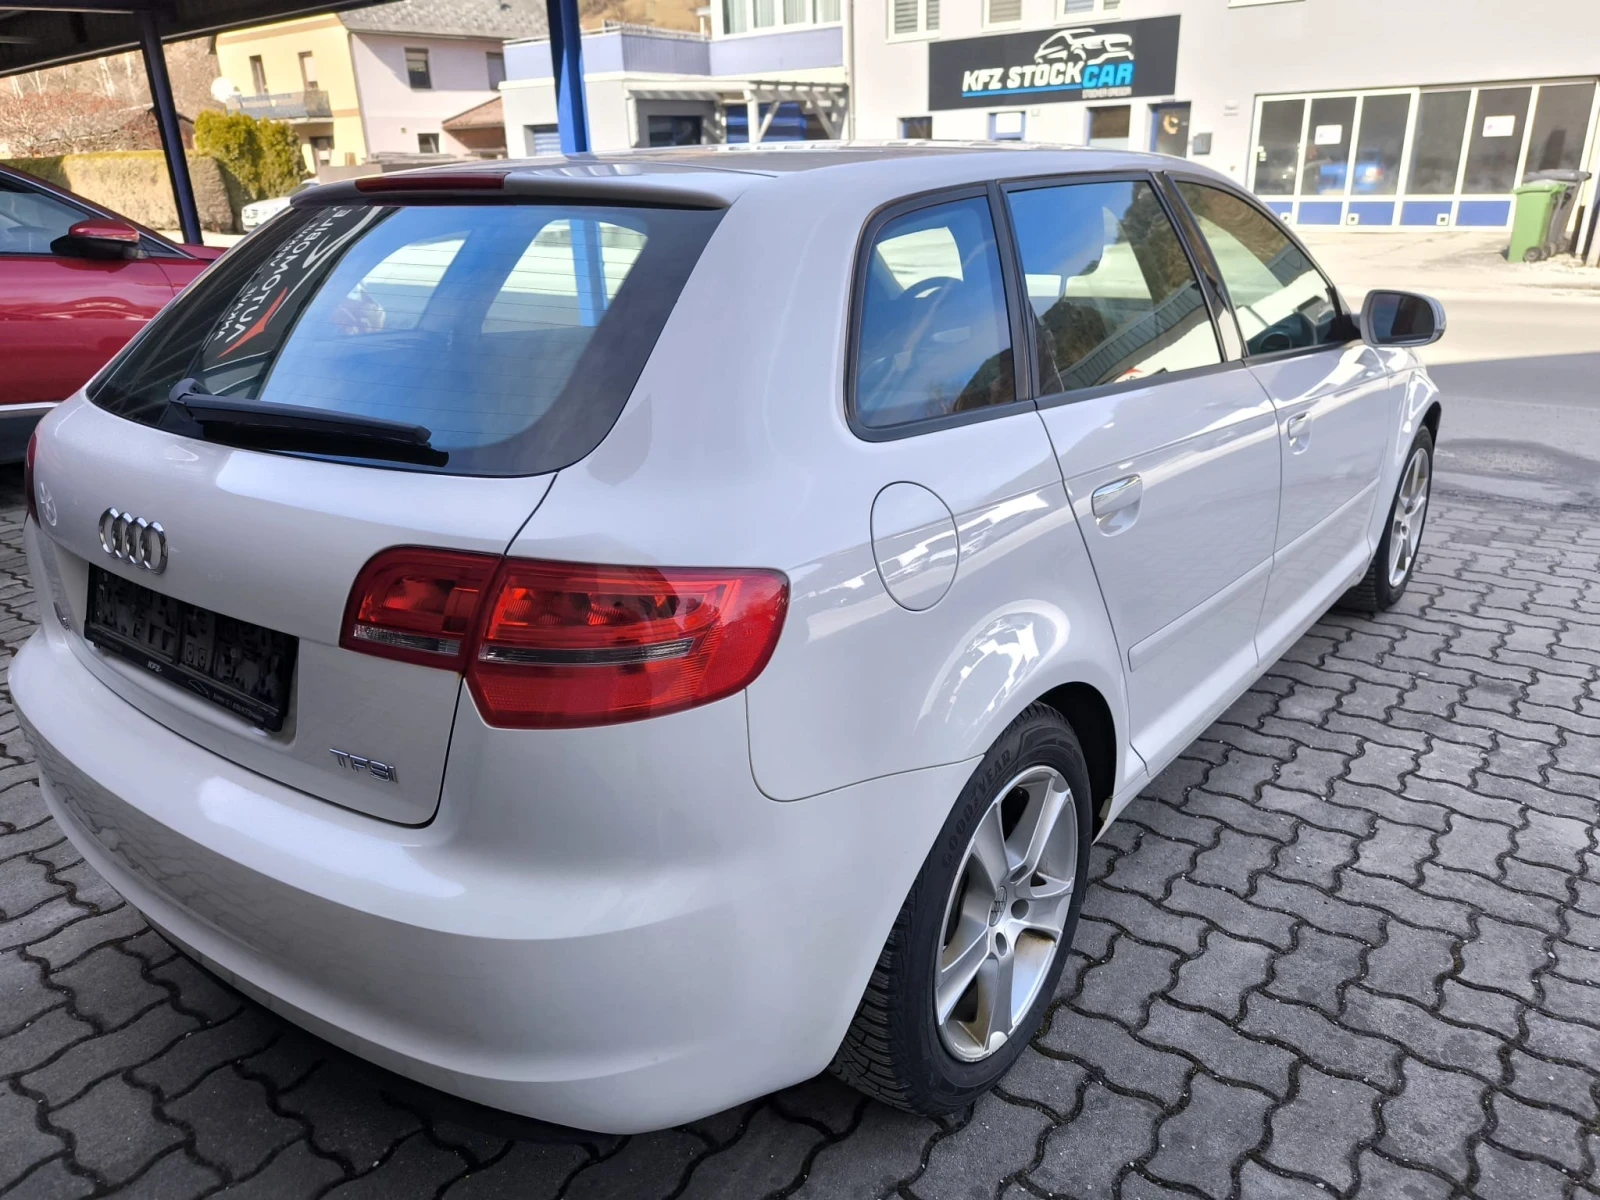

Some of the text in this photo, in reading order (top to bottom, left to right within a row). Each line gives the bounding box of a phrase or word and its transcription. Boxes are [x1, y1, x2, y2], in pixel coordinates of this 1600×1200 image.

[962, 67, 1004, 92] KFZ
[329, 748, 398, 783] TFSI
[942, 749, 1012, 867] GOODYEAR
